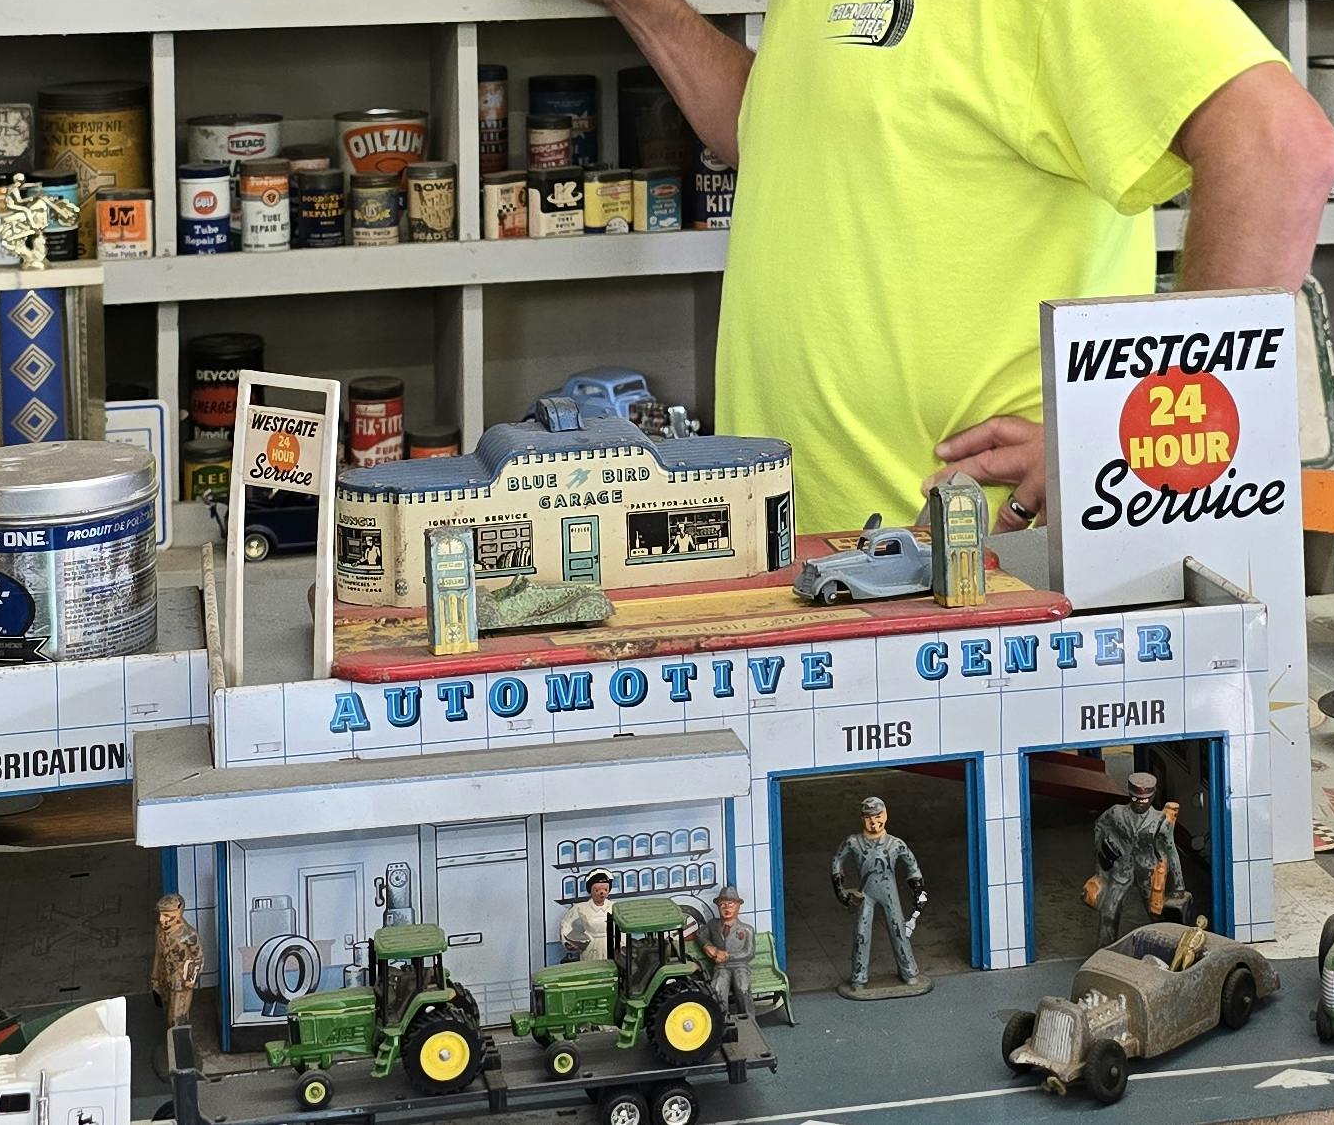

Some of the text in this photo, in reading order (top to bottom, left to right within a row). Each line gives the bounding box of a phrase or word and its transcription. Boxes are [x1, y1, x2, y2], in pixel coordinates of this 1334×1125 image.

[852, 20, 886, 35] TIRE
[67, 122, 103, 133] REPAIR
[83, 148, 124, 158] Product
[229, 139, 265, 151] TEXACO
[696, 175, 734, 191] REPAI
[194, 196, 215, 207] GULF
[706, 195, 732, 212] KIT
[262, 213, 281, 222] TUBE
[193, 225, 219, 235] Tube
[251, 223, 277, 234] REPAIR
[185, 235, 215, 245] Repair
[1067, 327, 1284, 383] WESTGATE
[1149, 383, 1207, 426] 24
[251, 413, 318, 438] WESTGATE
[278, 436, 291, 448] 24
[1129, 431, 1231, 469] HOUR
[271, 448, 295, 464] HOUR
[249, 453, 312, 486] Service
[507, 466, 650, 492] BLUE BIRD
[538, 490, 623, 509] GARAGE
[1081, 458, 1285, 531] Service
[630, 496, 724, 510] PARTS CARS
[339, 513, 376, 527] LUNCH
[428, 513, 529, 526] IGNITION SERVICE
[66, 521, 125, 541] PRODUIT DE
[330, 650, 834, 734] AUTOMOTIVE
[916, 624, 1174, 681] CENTER
[1080, 699, 1166, 731] REPAIR
[842, 721, 912, 753] TIRES
